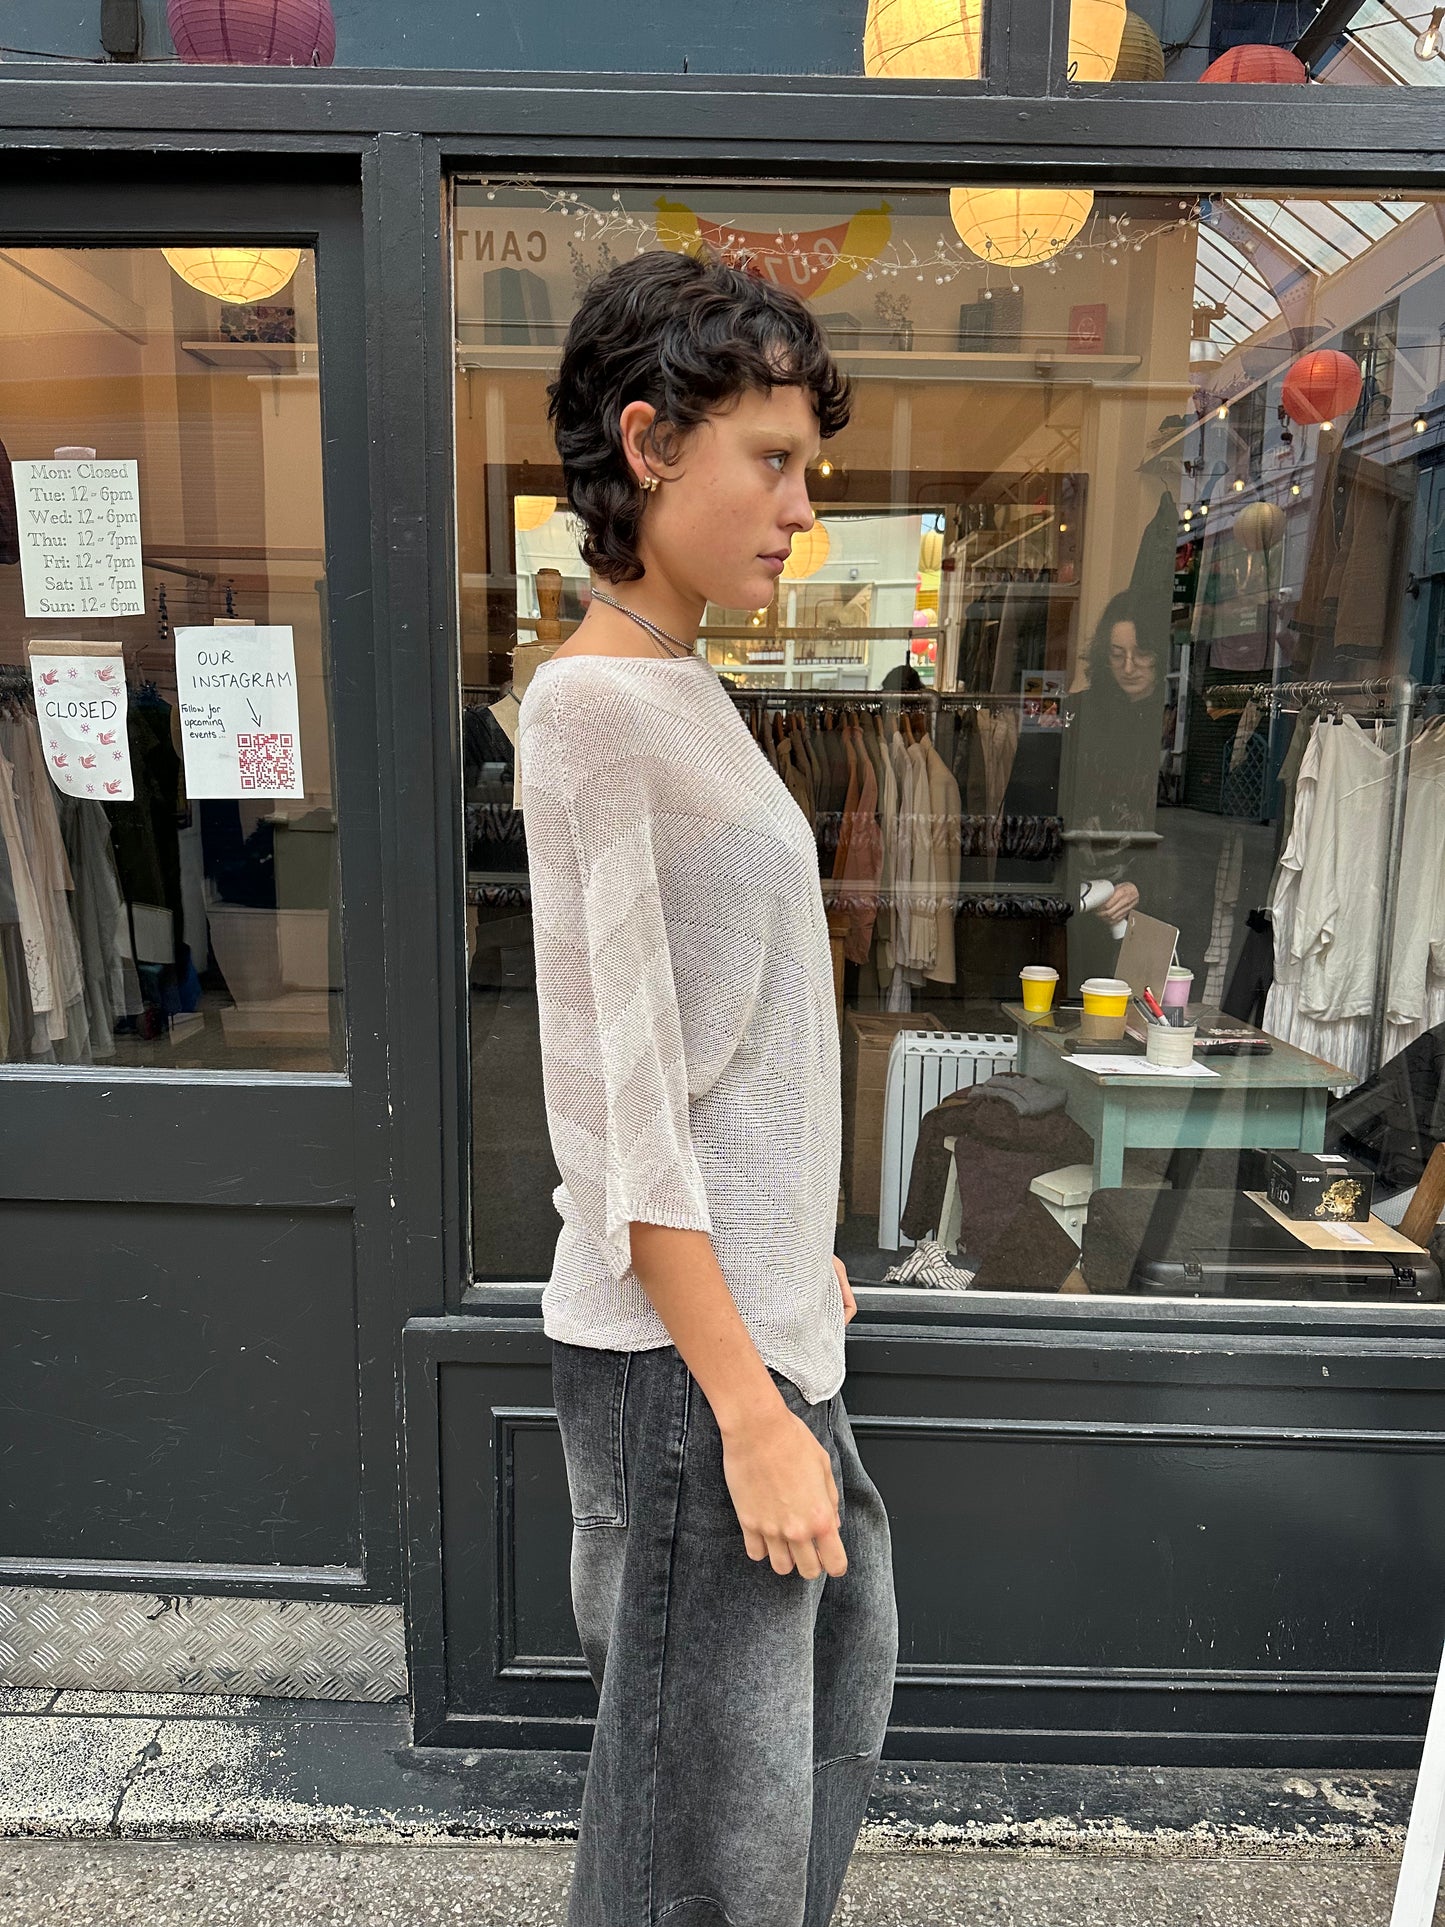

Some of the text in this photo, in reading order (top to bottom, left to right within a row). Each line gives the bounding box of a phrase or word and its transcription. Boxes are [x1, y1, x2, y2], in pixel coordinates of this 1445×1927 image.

[31, 463, 128, 479] Mon: Closed
[30, 487, 65, 501] Tue:
[71, 485, 88, 501] 12
[100, 486, 133, 504] 6pm
[29, 509, 72, 524] Wed:
[78, 508, 94, 524] 12
[107, 508, 138, 527] 6pm
[27, 532, 67, 547] Thu:
[77, 530, 95, 546] 12
[107, 531, 138, 549] 7pm
[43, 554, 70, 569] Fri:
[76, 552, 93, 569] 12
[106, 554, 136, 572] 7pm
[45, 576, 74, 591] Sat:
[79, 576, 93, 591] 11
[108, 576, 137, 594] 7pm
[39, 598, 76, 613] Sun:
[81, 597, 99, 612] 12
[111, 597, 141, 616] 6pm
[197, 650, 234, 666] OUR
[192, 672, 292, 689] INSTAGRAM
[45, 700, 117, 719] CLOSED
[181, 703, 221, 720] Follow for
[184, 718, 226, 733] upcoming
